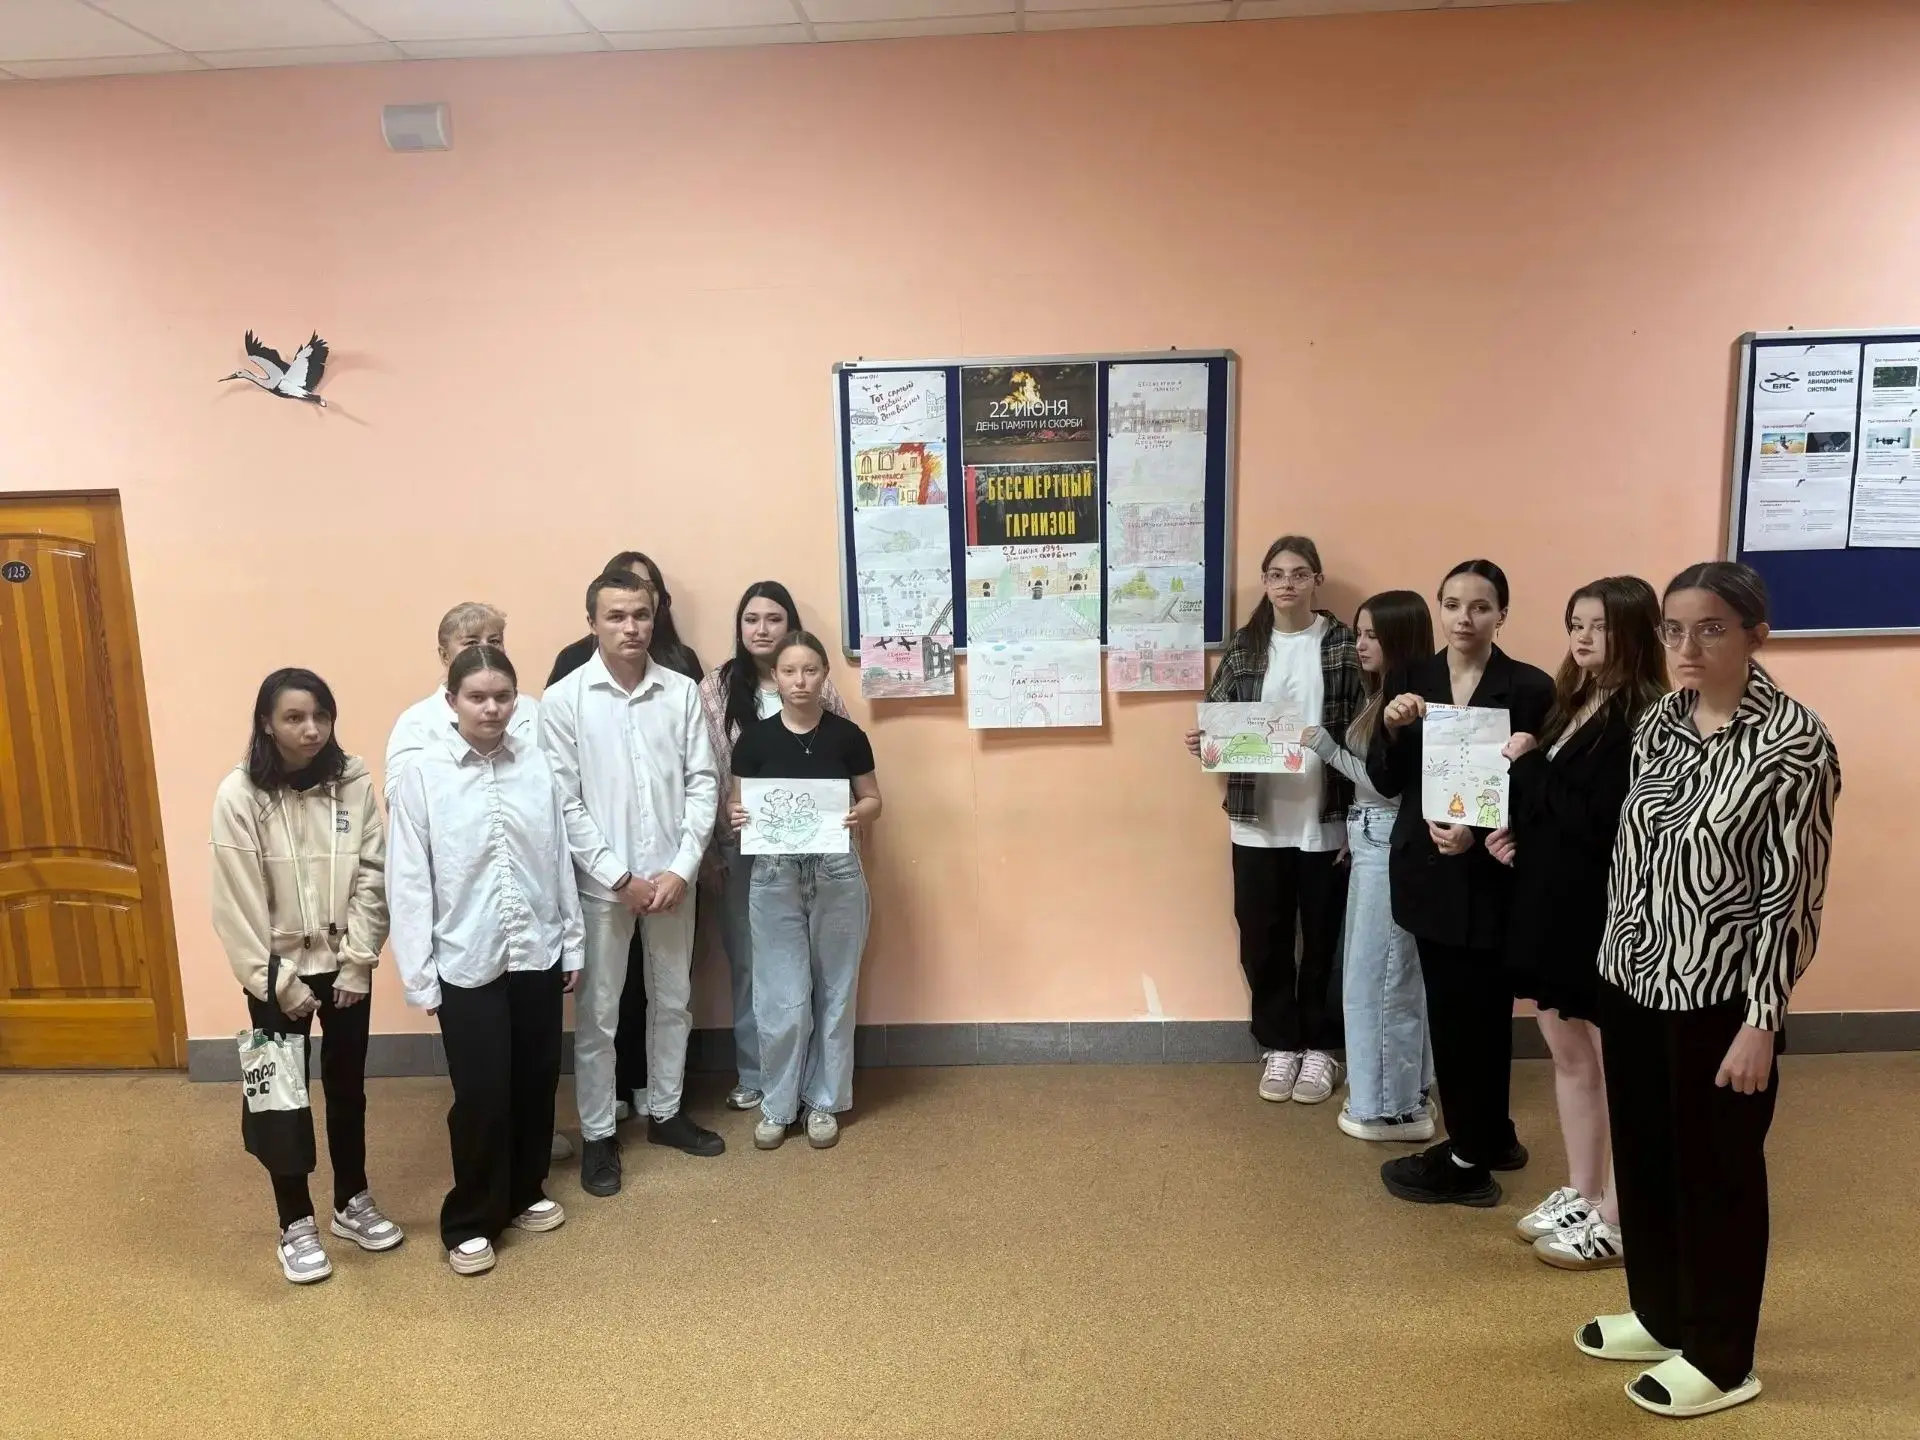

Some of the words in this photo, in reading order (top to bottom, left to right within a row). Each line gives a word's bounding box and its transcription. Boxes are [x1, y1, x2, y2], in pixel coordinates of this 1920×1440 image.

[1807, 369, 1854, 377] БЕСПИЛОТНЫЕ
[1807, 377, 1854, 385] АВИАЦИОННЫЕ
[989, 401, 1010, 418] 22
[1015, 399, 1068, 417] ИЮНЯ
[975, 421, 999, 432] ДЕНЬ
[1001, 420, 1038, 430] ПАМЯТИ
[1039, 419, 1046, 428] И
[1047, 418, 1083, 428] СКОРБИ
[988, 470, 1092, 501] БЕССМЕРТНЫЙ
[1006, 511, 1076, 538] ГАРНИЗОН
[1002, 546, 1016, 556] 22
[8, 565, 26, 579] 125
